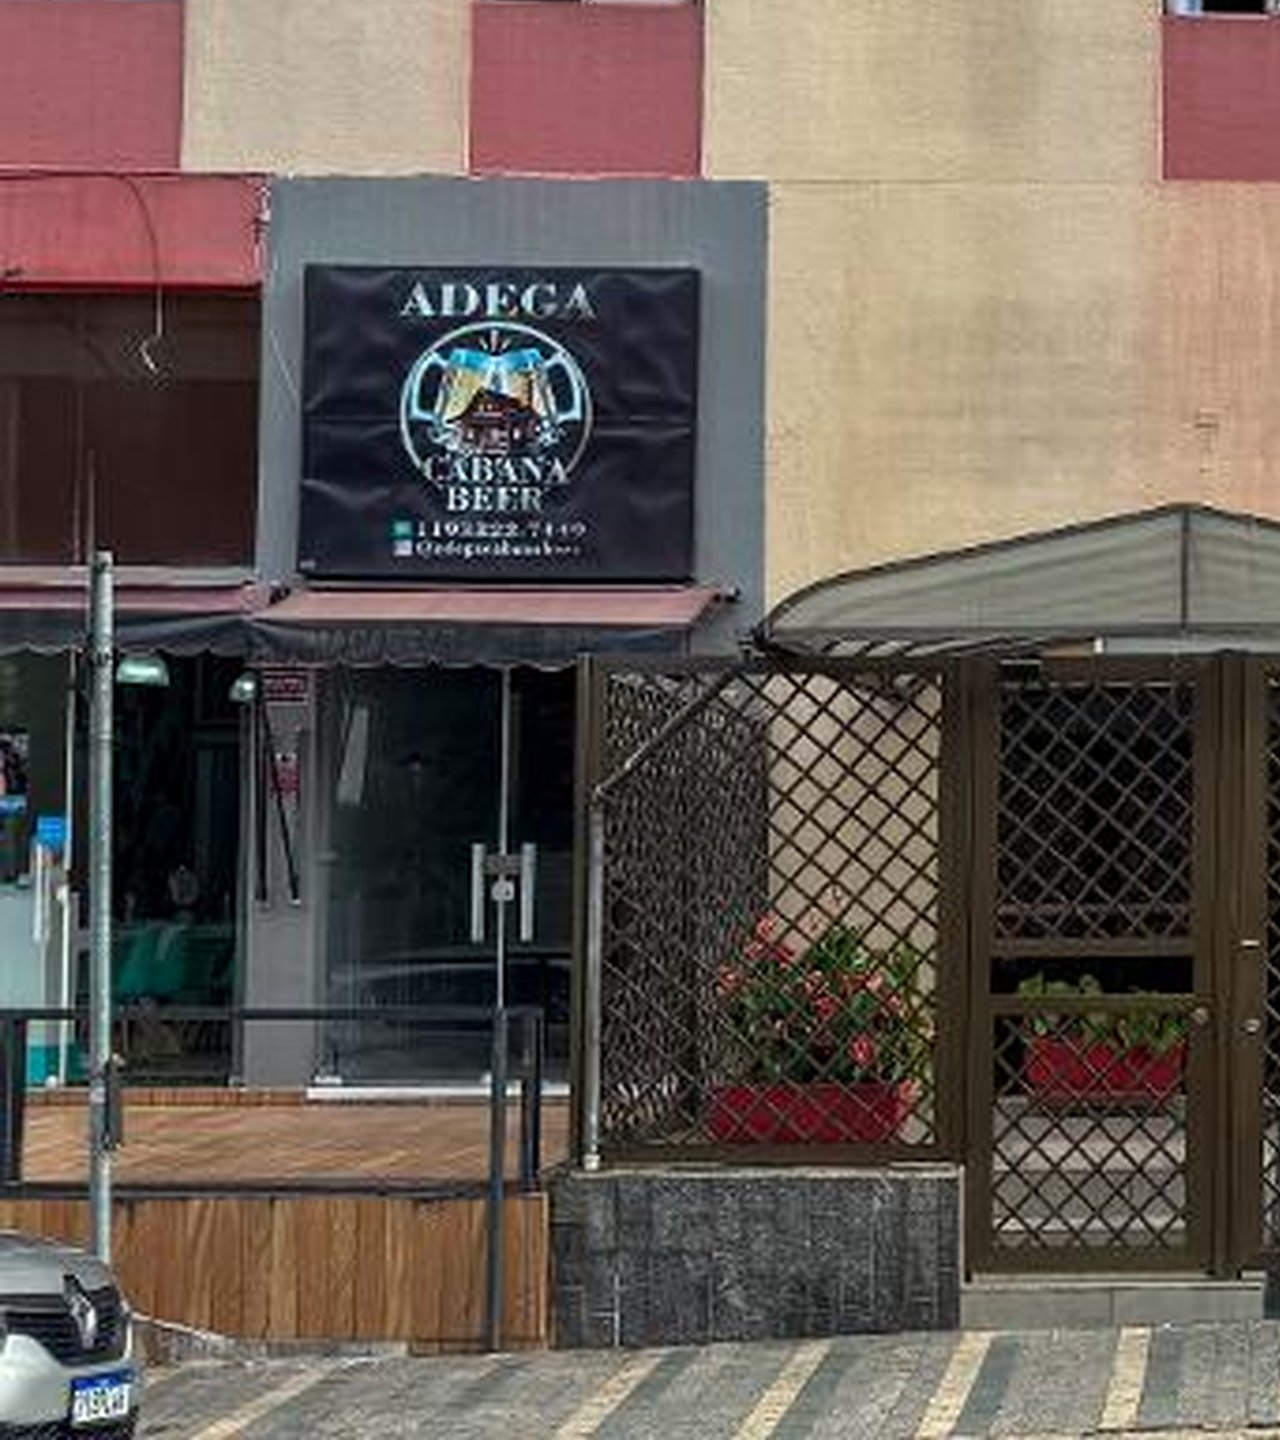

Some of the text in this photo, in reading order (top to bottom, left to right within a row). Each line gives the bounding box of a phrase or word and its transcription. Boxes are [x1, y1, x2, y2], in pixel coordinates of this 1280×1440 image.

[400, 281, 598, 319] ADEGA
[424, 455, 573, 485] CABANA
[447, 485, 544, 511] BEER
